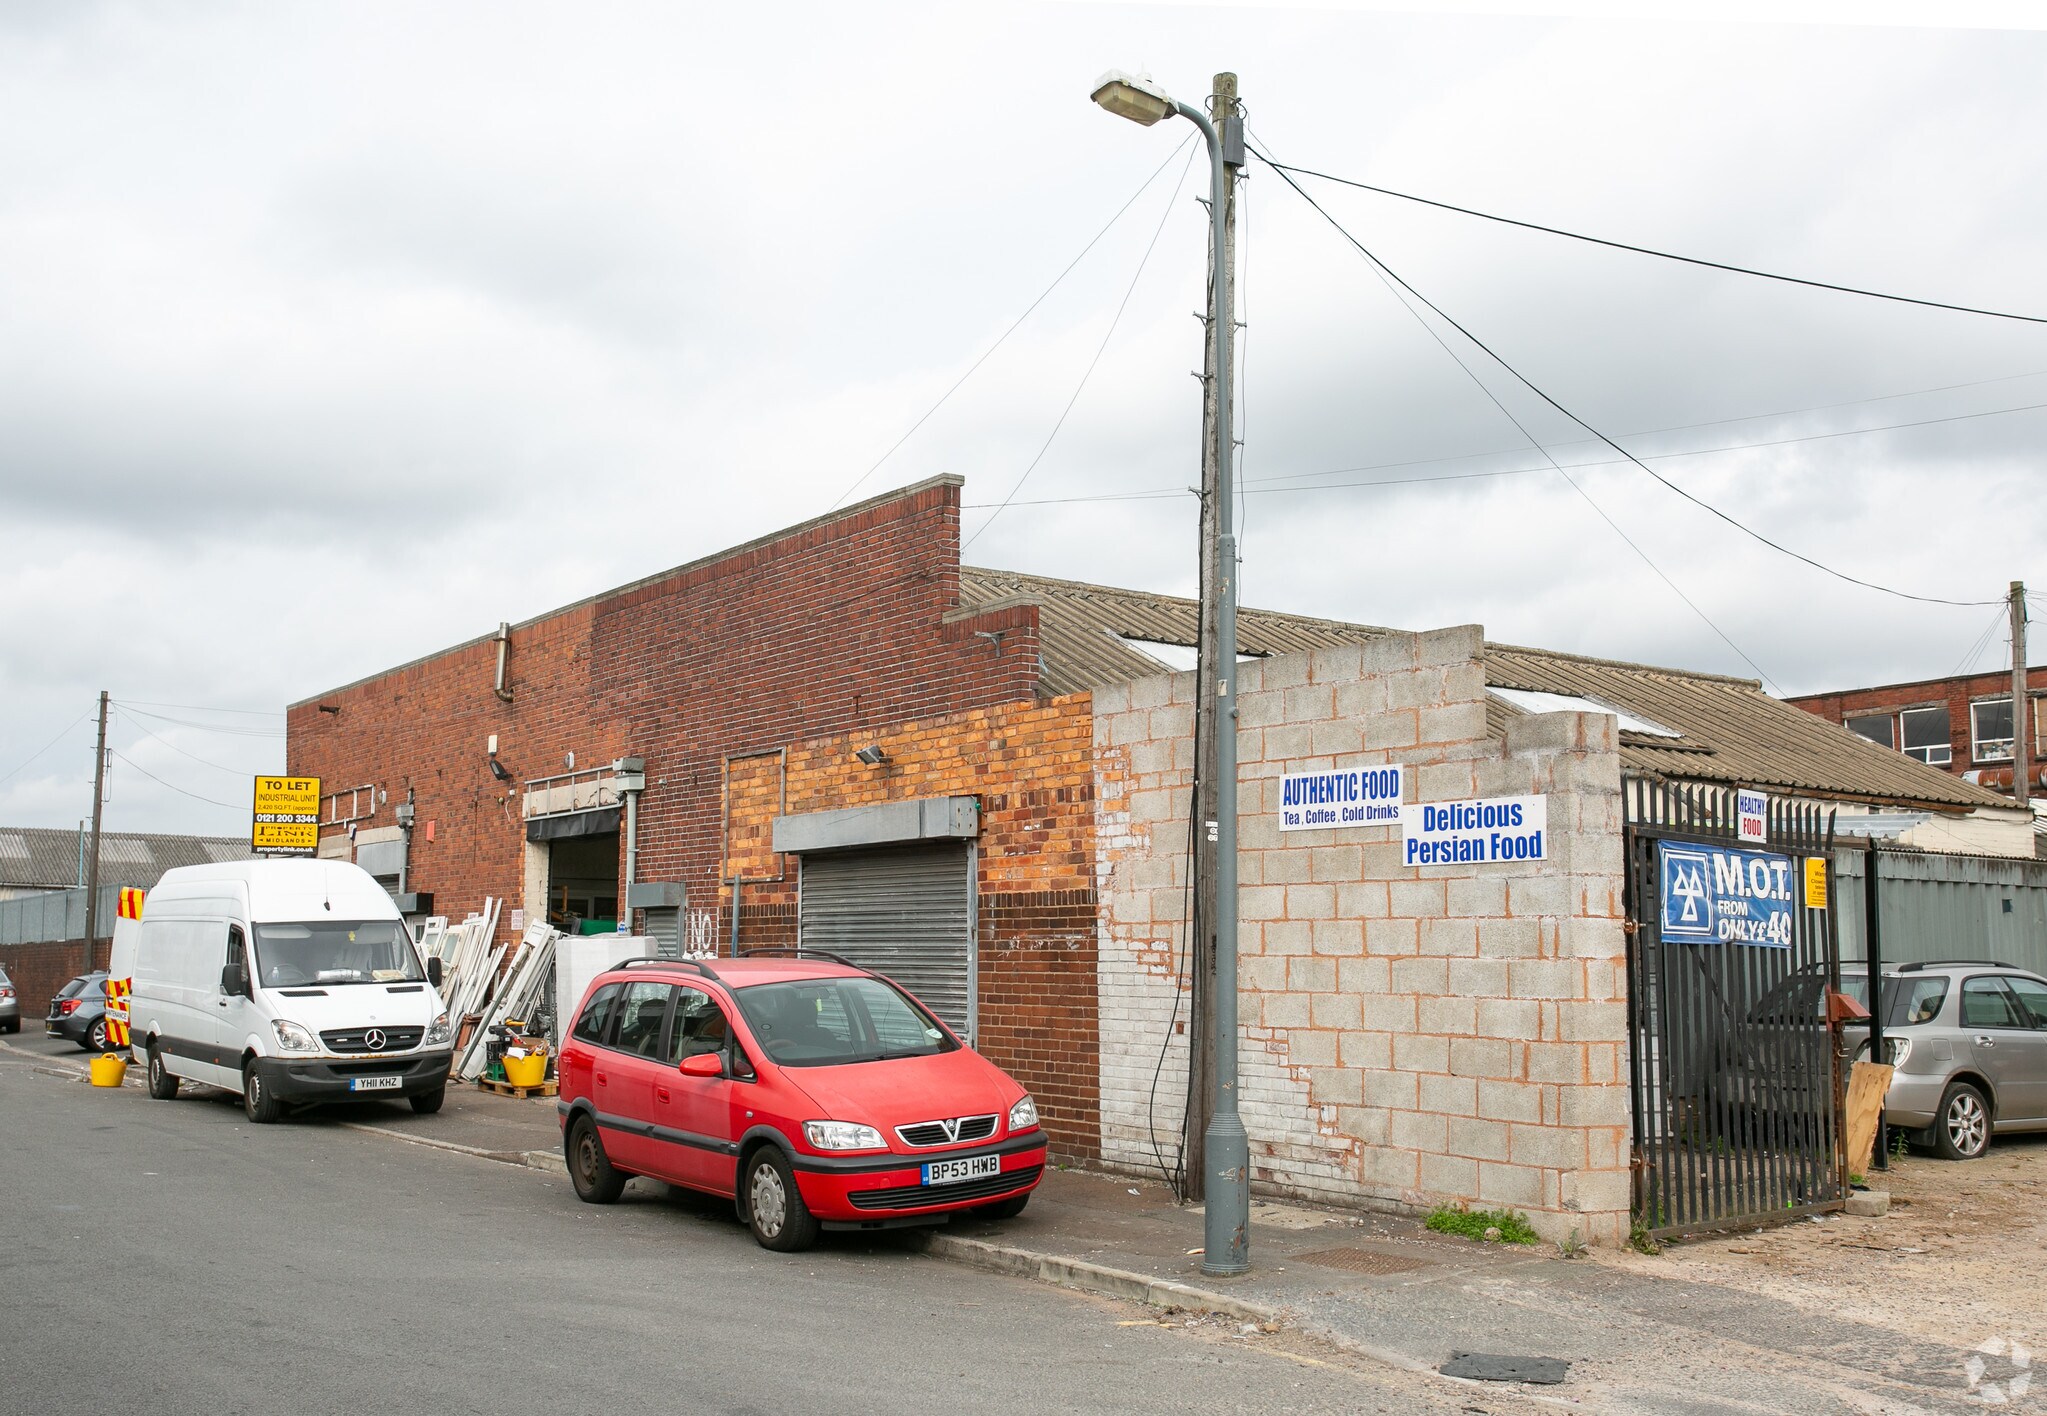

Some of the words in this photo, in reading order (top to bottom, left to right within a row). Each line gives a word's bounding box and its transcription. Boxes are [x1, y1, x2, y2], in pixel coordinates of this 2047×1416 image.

[265, 781, 282, 790] TO
[287, 781, 311, 791] LET
[1283, 773, 1357, 806] AUTHENTIC
[1362, 769, 1399, 801] FOOD
[258, 793, 299, 802] INDUSTRIAL
[300, 794, 316, 802] UNIT
[1739, 795, 1765, 816] HEALTHY
[257, 814, 275, 823] 0121
[276, 814, 293, 823] 200
[295, 814, 317, 823] 3344
[1342, 806, 1364, 821] Cold
[1366, 804, 1399, 820] Drinks
[1424, 802, 1523, 832] Delicious
[1743, 817, 1762, 836] FOOD
[1407, 835, 1485, 864] Persian
[1490, 830, 1543, 860] Food
[1712, 853, 1791, 900] M.O.T.
[1717, 900, 1748, 916] FROM
[690, 909, 712, 950] NO
[379, 1077, 397, 1086] KHZ
[932, 1161, 968, 1180] BP53
[972, 1157, 997, 1174] HWB
